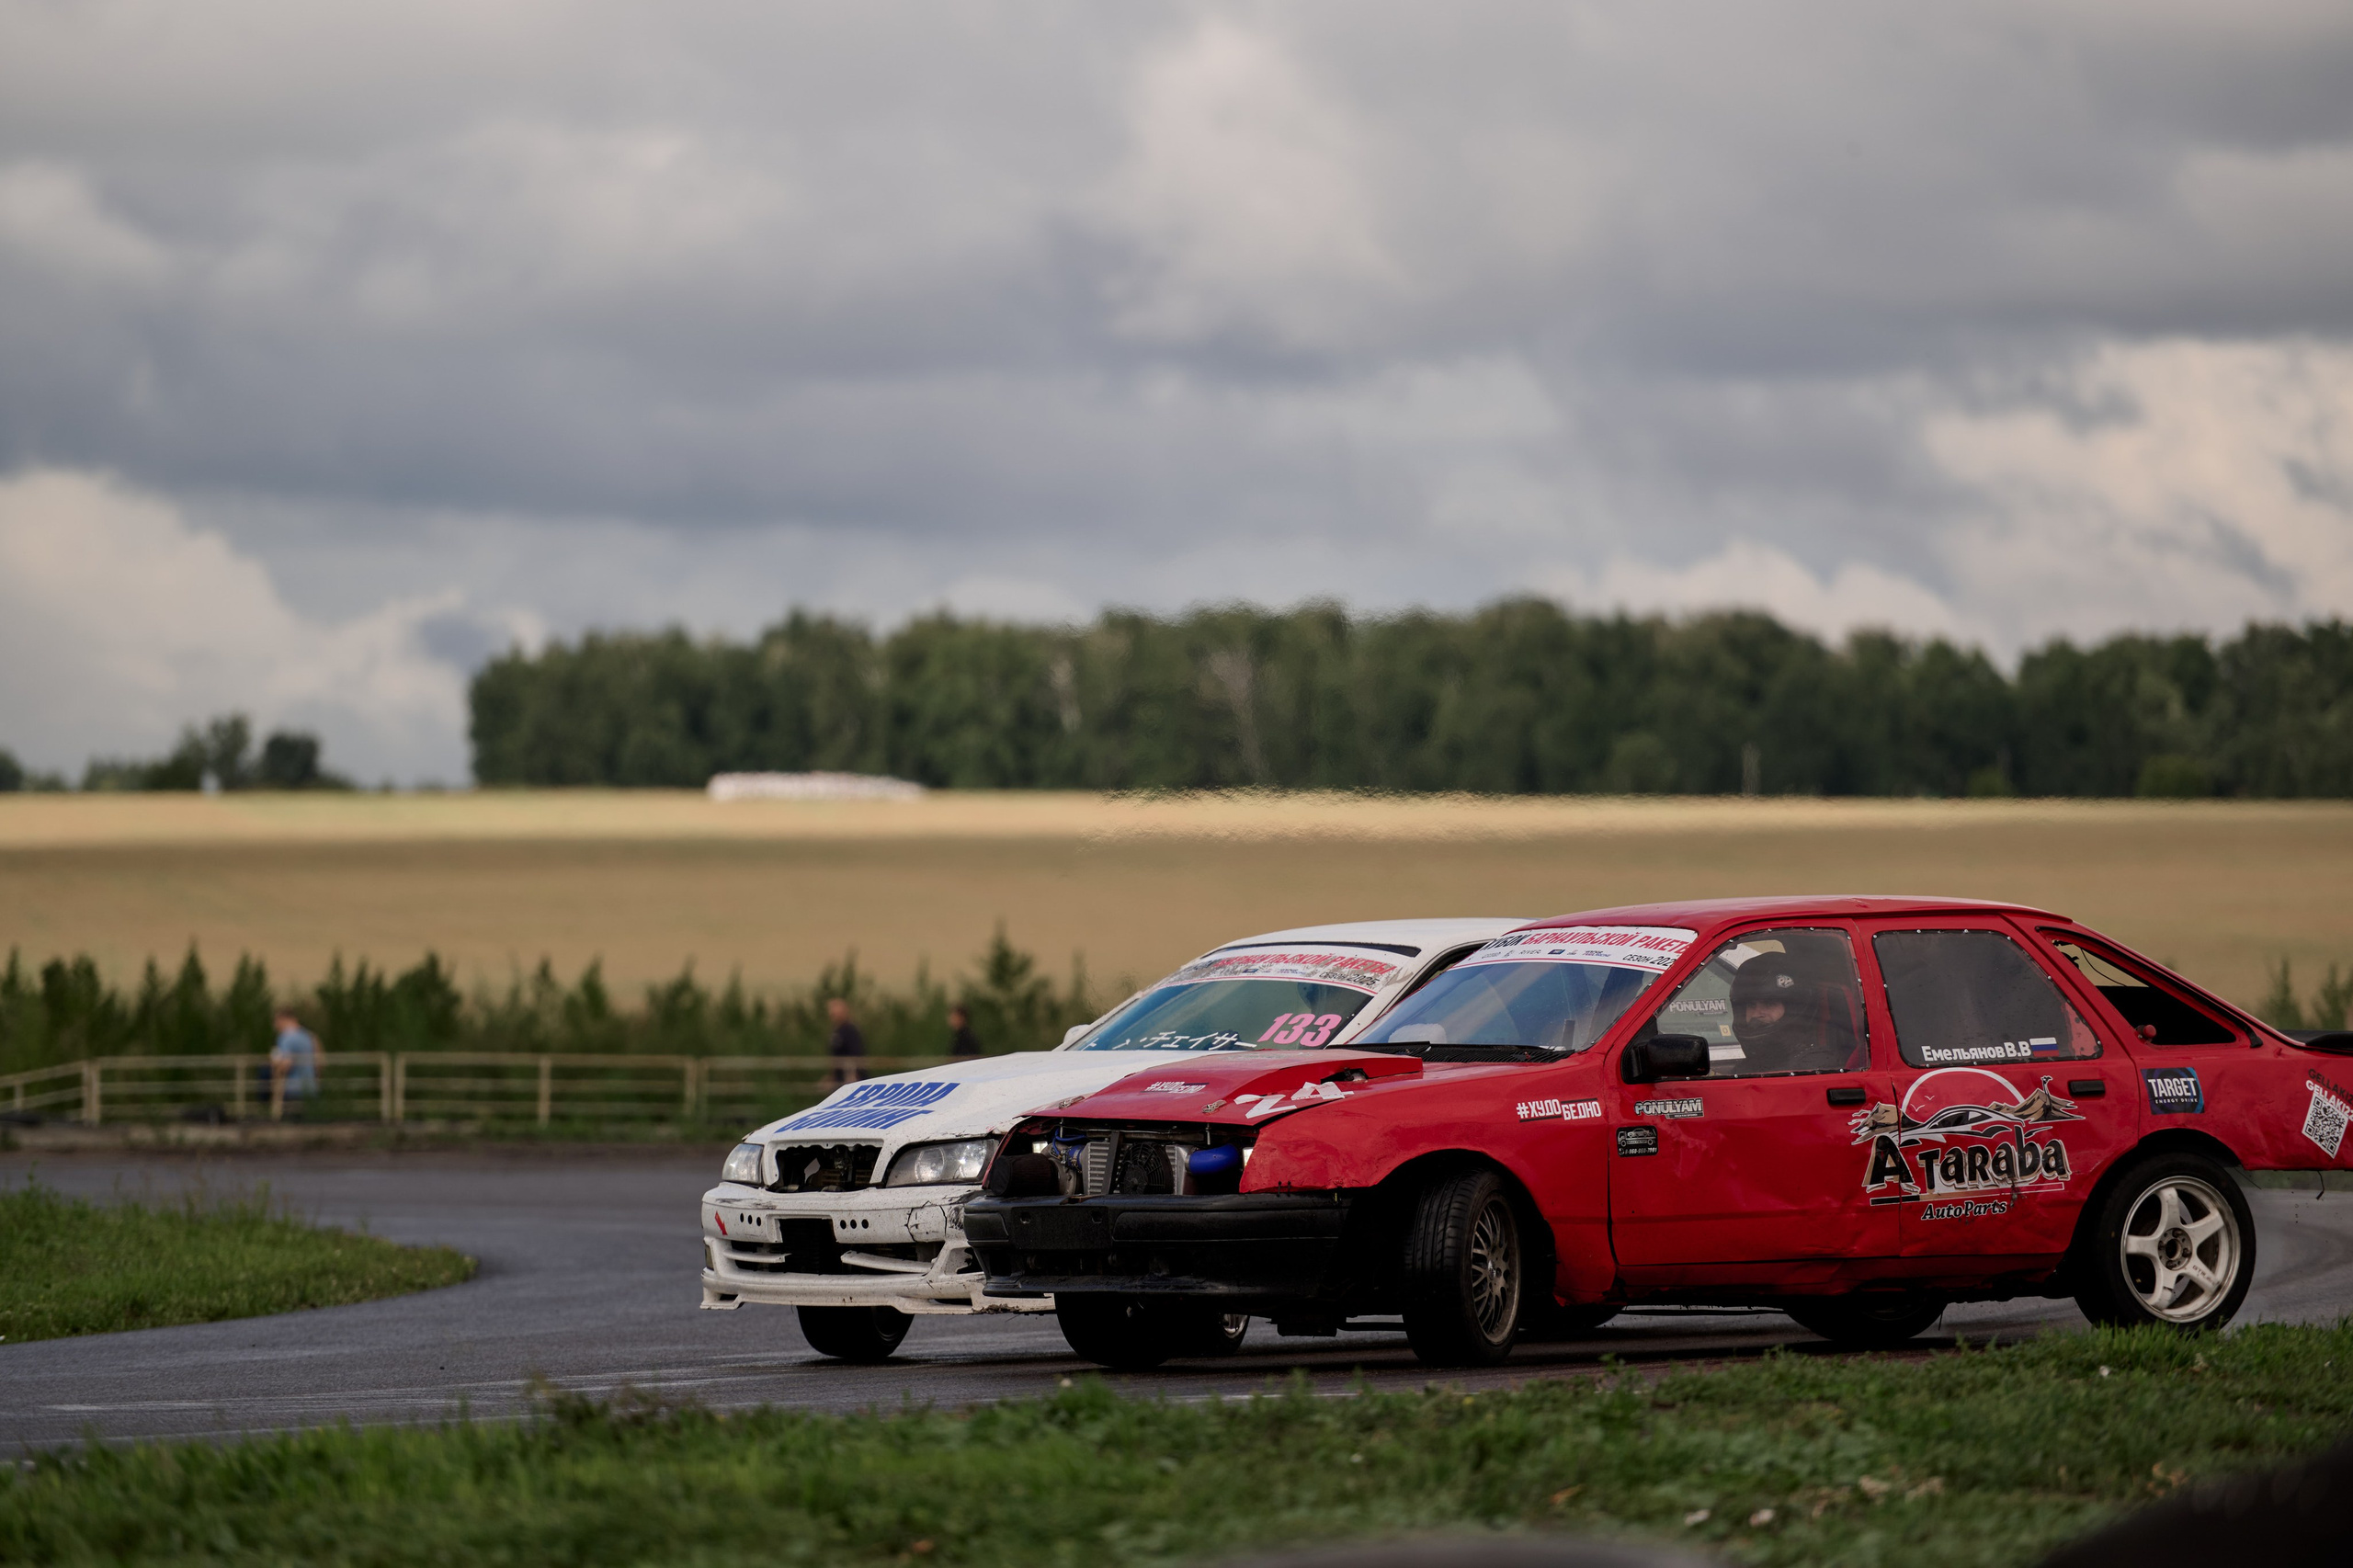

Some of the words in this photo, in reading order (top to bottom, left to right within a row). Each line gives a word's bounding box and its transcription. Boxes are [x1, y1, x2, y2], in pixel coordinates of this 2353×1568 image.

[1520, 931, 1642, 947] БАРНАУЛЬСКОЙ
[1324, 956, 1397, 974] РАКЕТЫ
[1347, 974, 1380, 985] 2025
[1669, 999, 1726, 1013] PONULYAM
[1257, 1013, 1342, 1047] 133
[1921, 1042, 2006, 1062] Емельянов
[823, 1082, 961, 1109] ЕВРОПА
[2147, 1077, 2197, 1097] TARGET
[1634, 1098, 1702, 1115] PONULYAM
[774, 1108, 935, 1134] БОУЛИНГ
[1921, 1199, 2007, 1221] AutoParts
